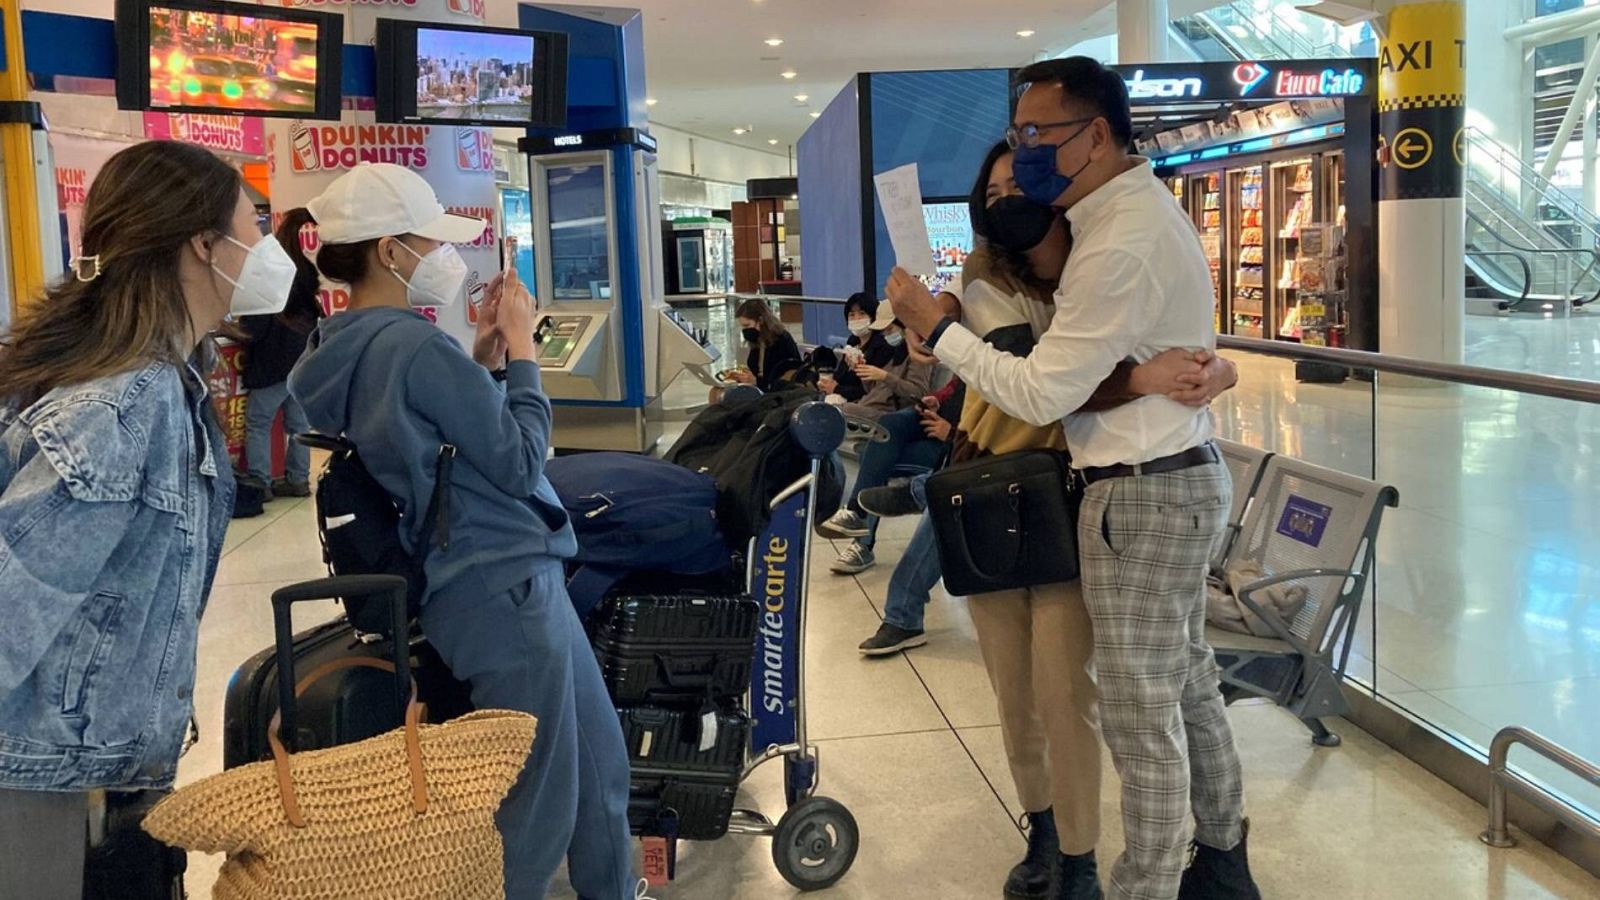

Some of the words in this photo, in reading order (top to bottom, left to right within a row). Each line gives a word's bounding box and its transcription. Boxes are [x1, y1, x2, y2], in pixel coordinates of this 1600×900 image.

[1380, 40, 1432, 75] AXI
[191, 123, 243, 149] DONUTS
[321, 125, 430, 146] DUNKIN'
[554, 135, 582, 146] HOTELS
[322, 147, 427, 169] DONUTS
[760, 536, 789, 716] smartecarte
